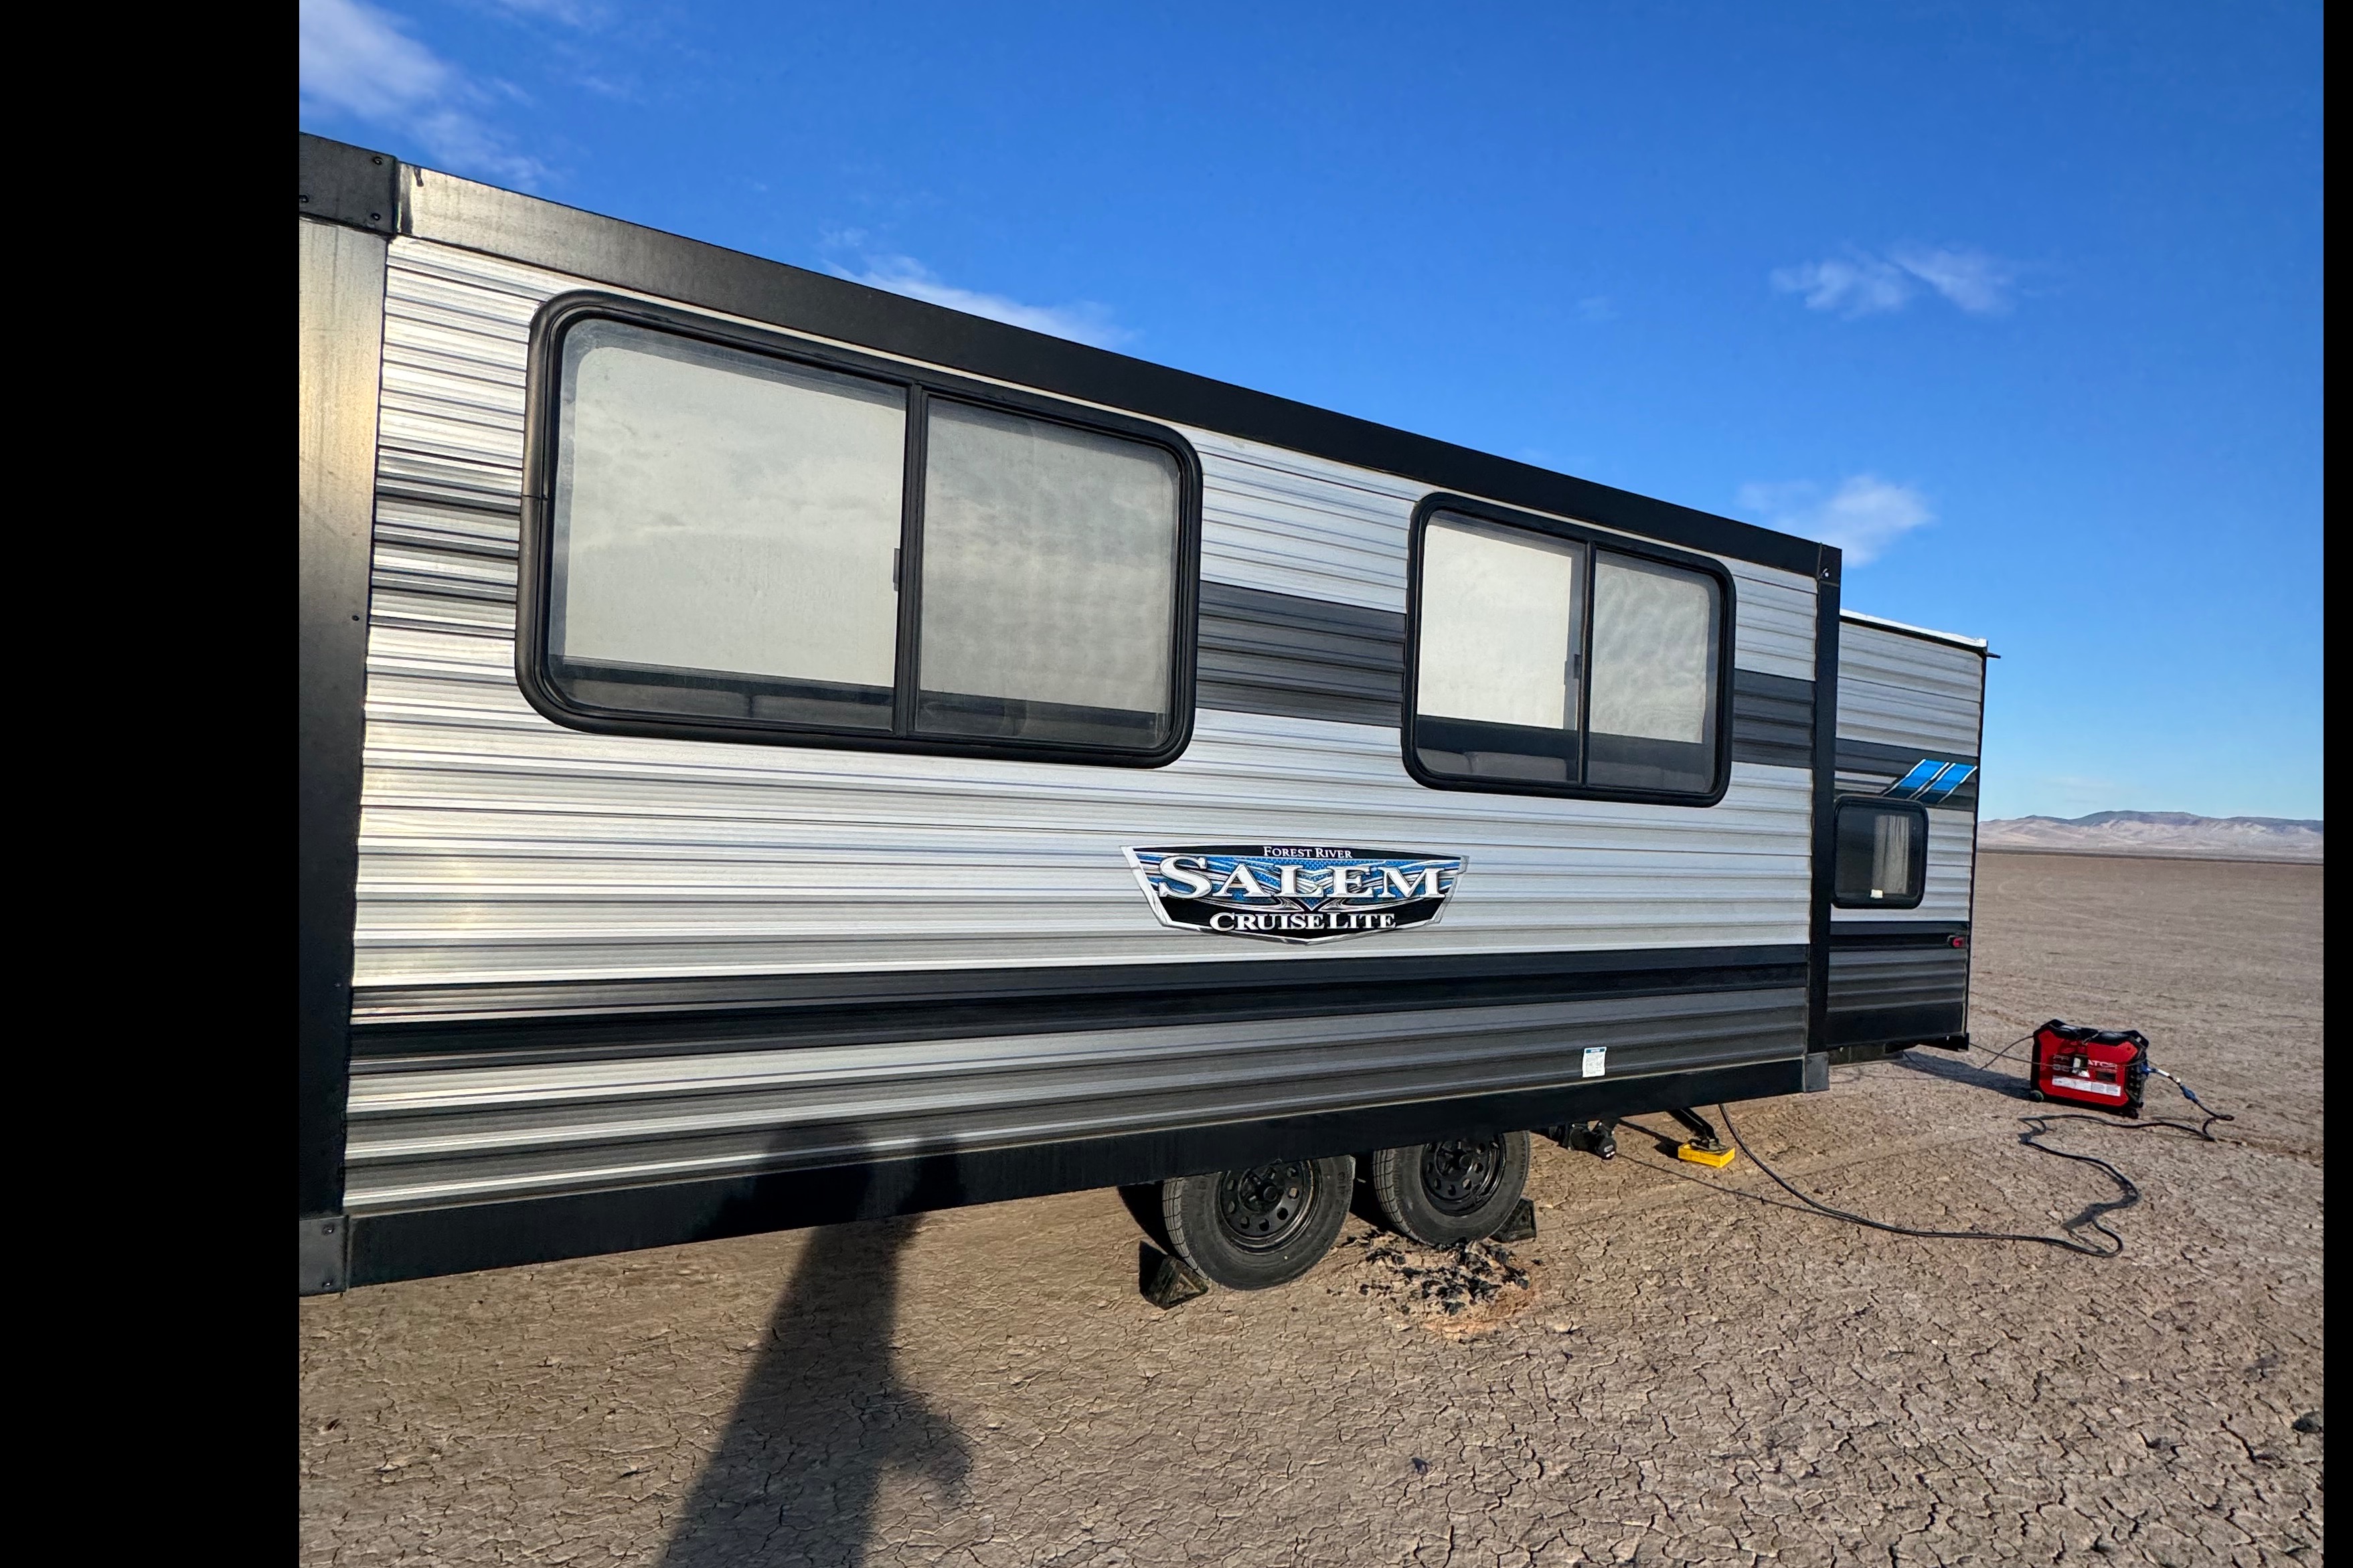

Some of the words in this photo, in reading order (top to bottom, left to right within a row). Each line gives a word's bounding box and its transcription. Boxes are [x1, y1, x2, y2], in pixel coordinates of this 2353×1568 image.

[1263, 846, 1313, 857] FOREST
[1315, 847, 1353, 859] RIVER
[1159, 855, 1446, 899] SALEM
